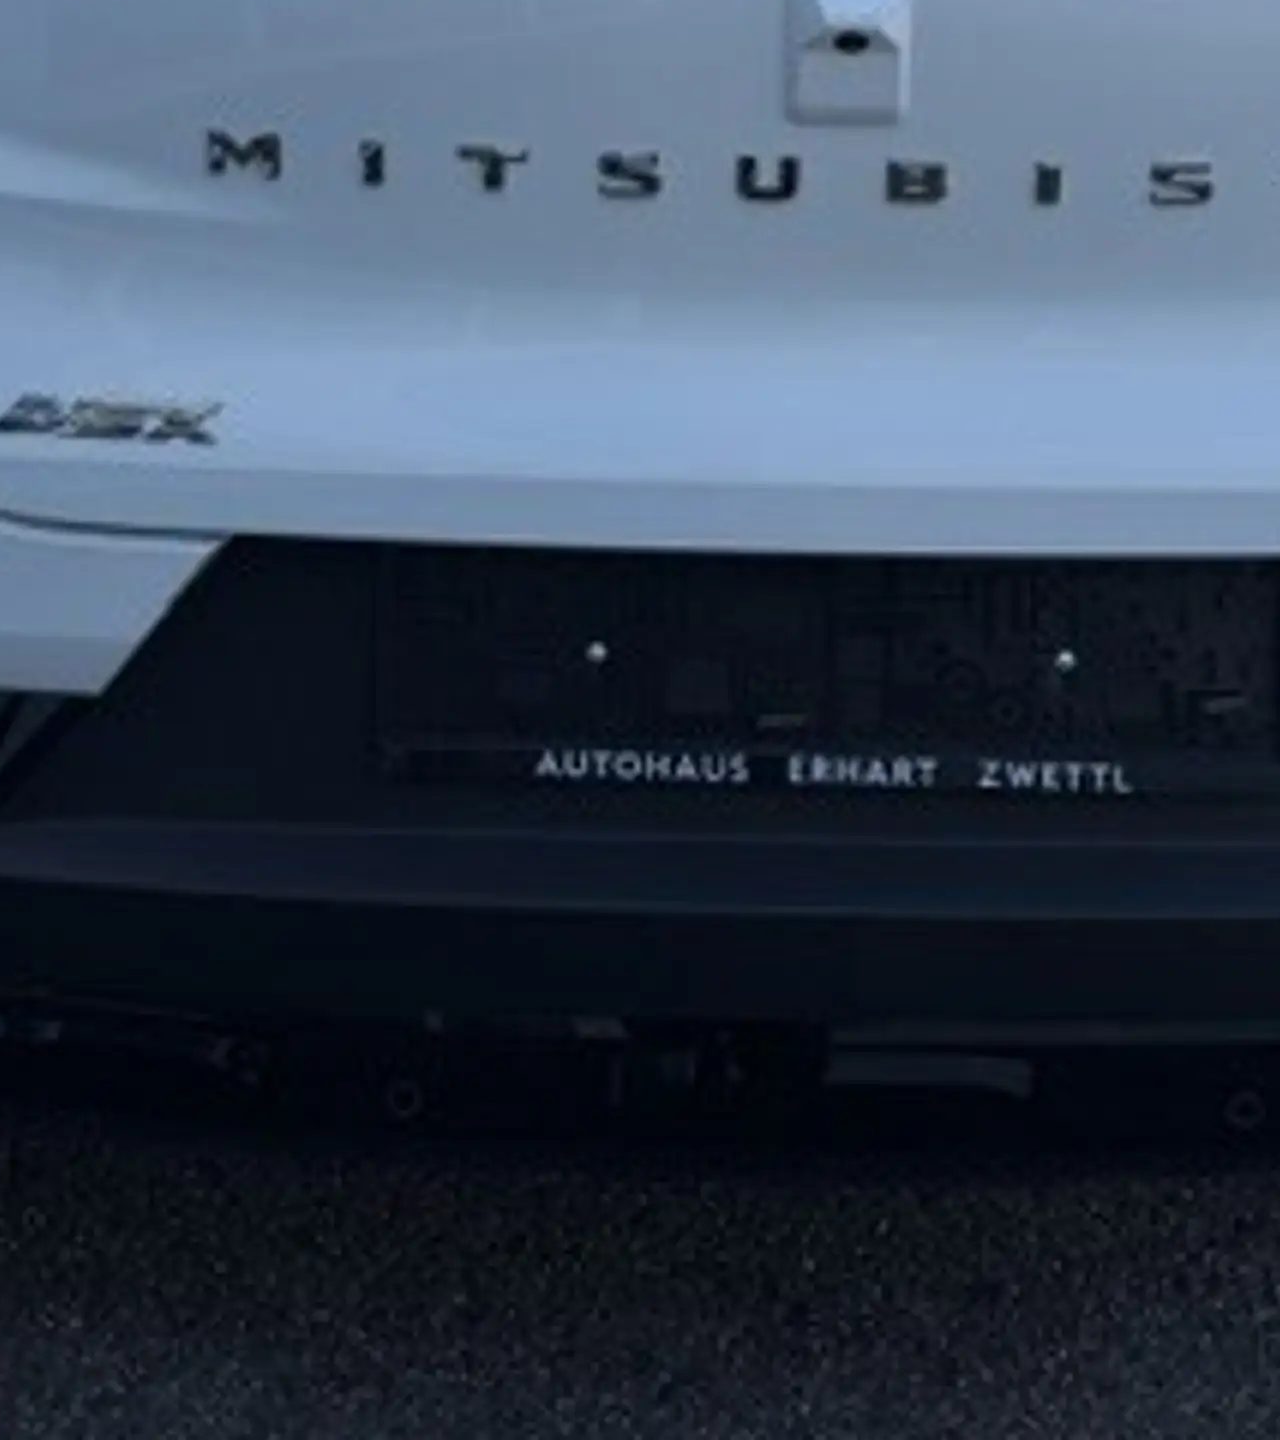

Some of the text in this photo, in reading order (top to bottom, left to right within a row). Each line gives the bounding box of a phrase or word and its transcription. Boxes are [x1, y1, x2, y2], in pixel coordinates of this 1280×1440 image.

[534, 749, 1134, 794] AUTOHAUS ERHART ZWETTL
